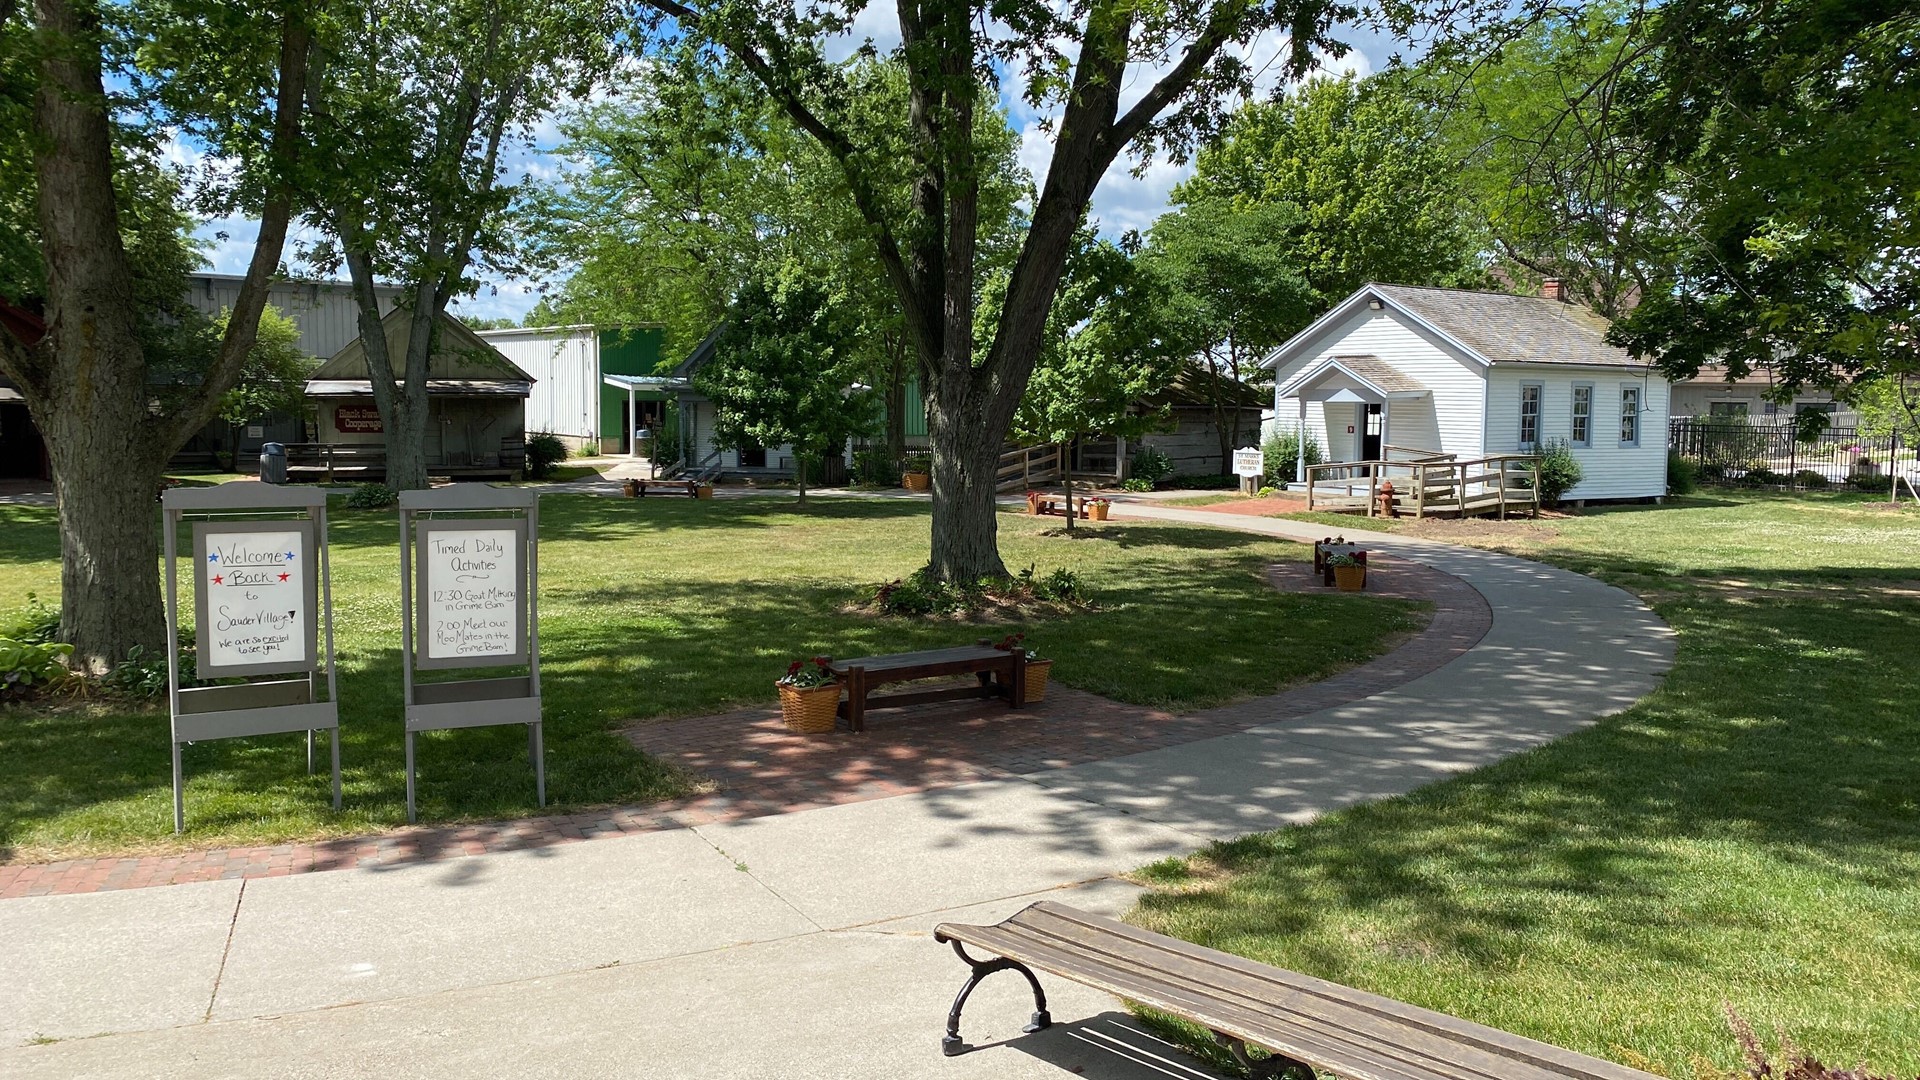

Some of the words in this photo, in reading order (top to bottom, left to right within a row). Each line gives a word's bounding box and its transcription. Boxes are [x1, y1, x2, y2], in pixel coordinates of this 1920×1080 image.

[338, 409, 361, 418] Black
[361, 409, 379, 418] Swa
[345, 418, 381, 430] Cooperage
[217, 542, 283, 565] Welcome
[431, 539, 466, 554] Timed
[475, 538, 504, 558] Daily
[450, 557, 496, 572] Activities
[228, 570, 274, 586] Back
[245, 590, 259, 600] to
[433, 590, 463, 602] 12:30
[465, 590, 485, 602] Goat
[487, 587, 516, 602] Milking
[455, 601, 483, 611] Grime
[484, 601, 505, 610] Barn
[463, 617, 487, 630] Meet
[489, 620, 508, 628] our
[494, 632, 510, 640] the
[218, 638, 232, 649] We
[234, 638, 250, 646] are
[238, 646, 248, 654] to
[248, 645, 261, 653] see
[262, 643, 281, 656] you!
[455, 643, 484, 655] Grime
